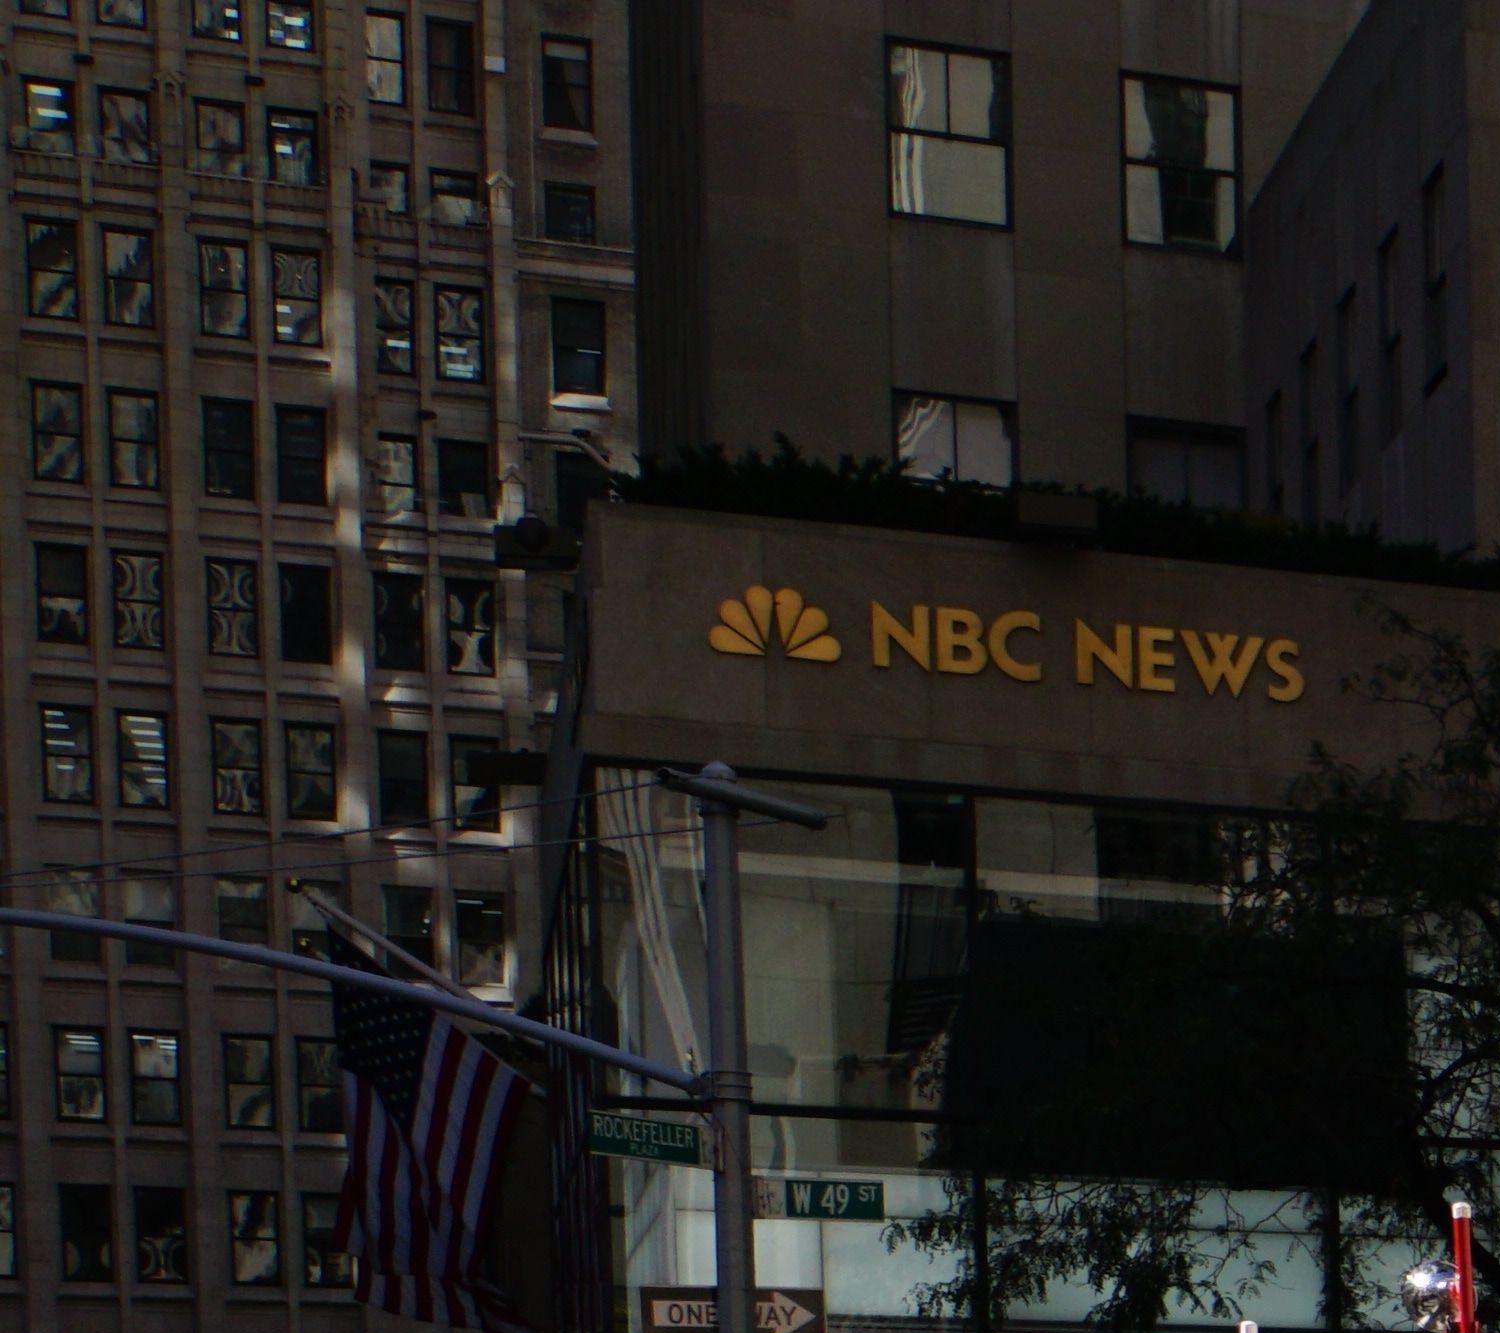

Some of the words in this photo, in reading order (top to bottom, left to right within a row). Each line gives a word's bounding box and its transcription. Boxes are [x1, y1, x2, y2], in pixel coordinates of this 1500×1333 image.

[871, 601, 1042, 683] NBC
[1075, 618, 1304, 702] NEWS
[592, 1112, 694, 1149] ROCKEFELLER
[629, 1142, 659, 1156] PLAZA
[792, 1185, 812, 1215] W
[821, 1184, 850, 1215] 49
[857, 1185, 879, 1202] ST
[668, 1303, 718, 1325] ONE
